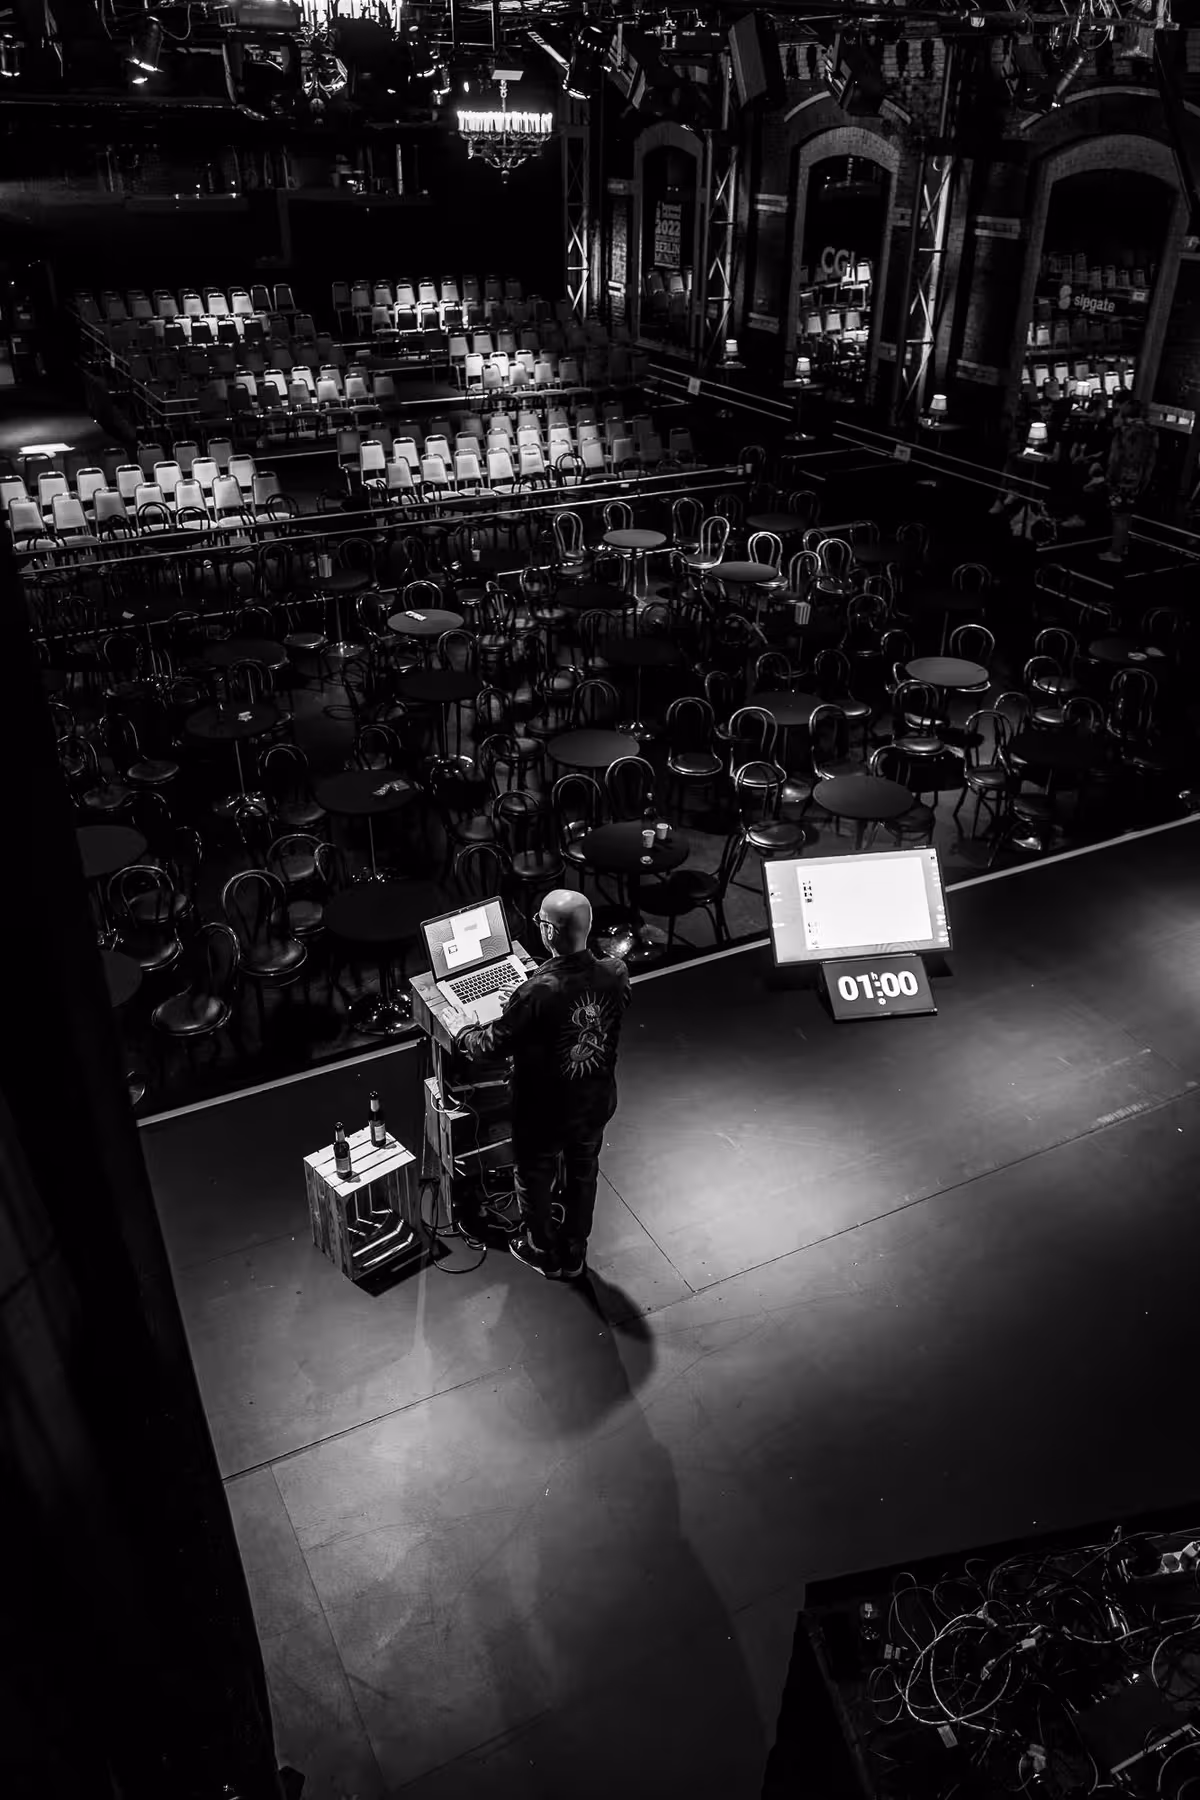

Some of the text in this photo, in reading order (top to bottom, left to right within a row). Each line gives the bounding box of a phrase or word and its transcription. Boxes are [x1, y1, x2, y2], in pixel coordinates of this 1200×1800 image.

[655, 219, 681, 236] 2022
[821, 246, 856, 278] CGI
[1073, 294, 1116, 314] sipgate
[837, 970, 919, 1002] 01:00
